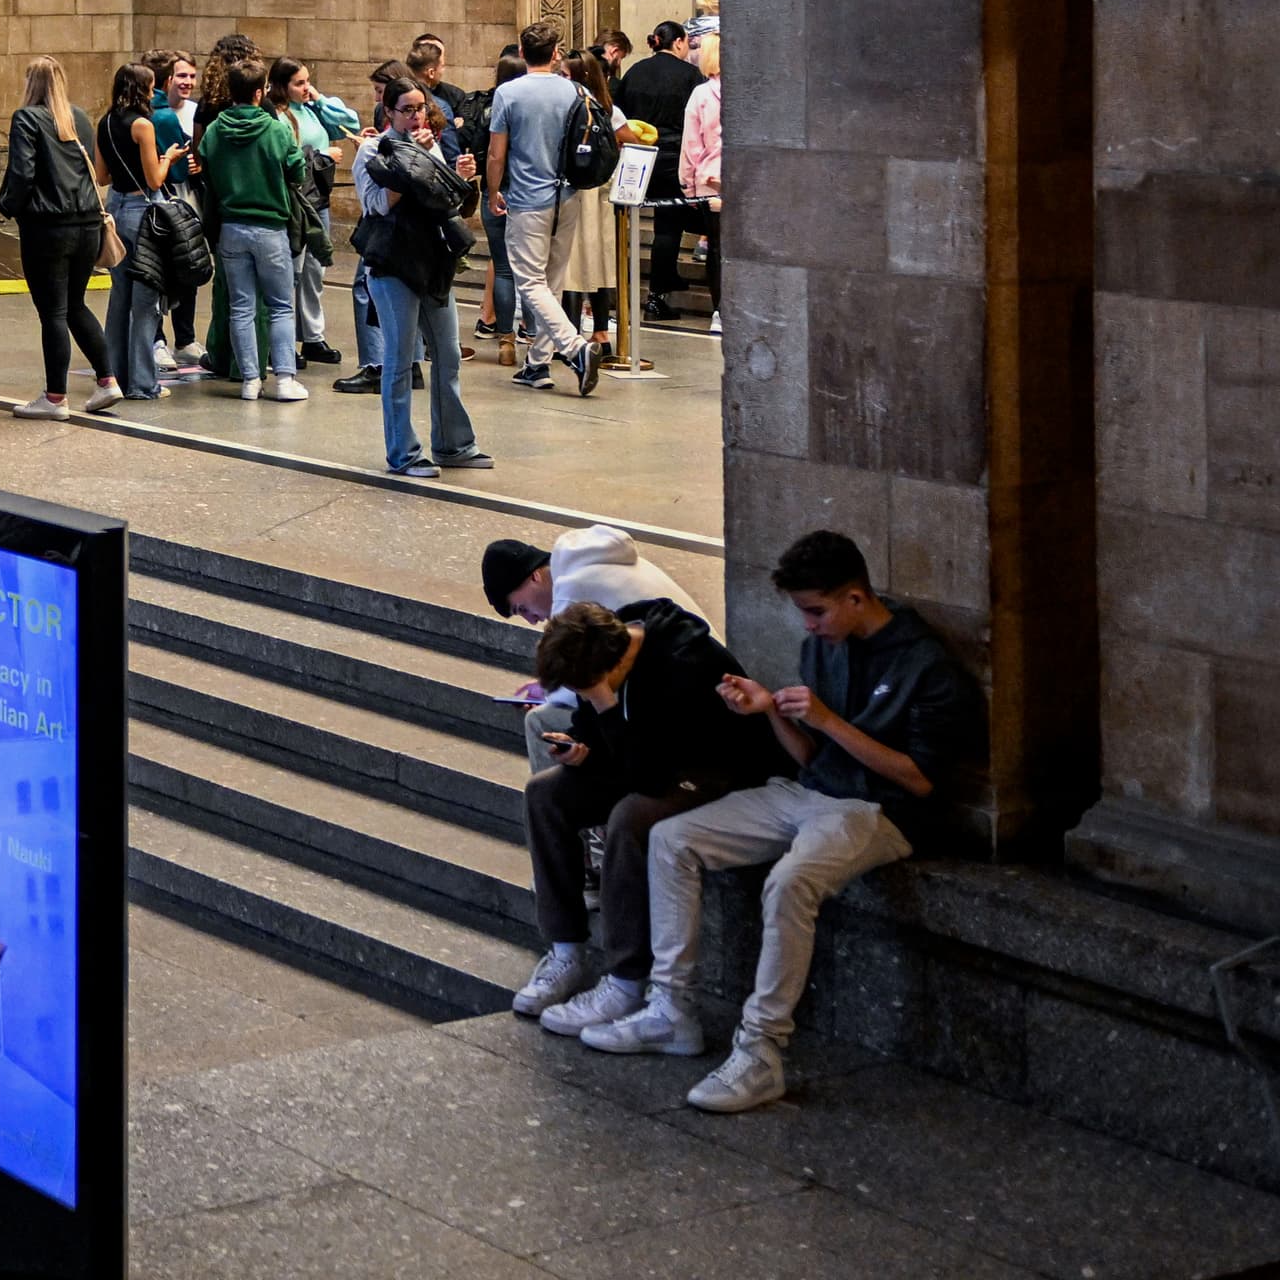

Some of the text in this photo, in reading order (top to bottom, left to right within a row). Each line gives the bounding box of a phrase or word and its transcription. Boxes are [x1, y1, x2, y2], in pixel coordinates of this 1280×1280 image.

[37, 672, 52, 698] in
[35, 711, 64, 743] Art
[7, 836, 52, 872] Nauki
